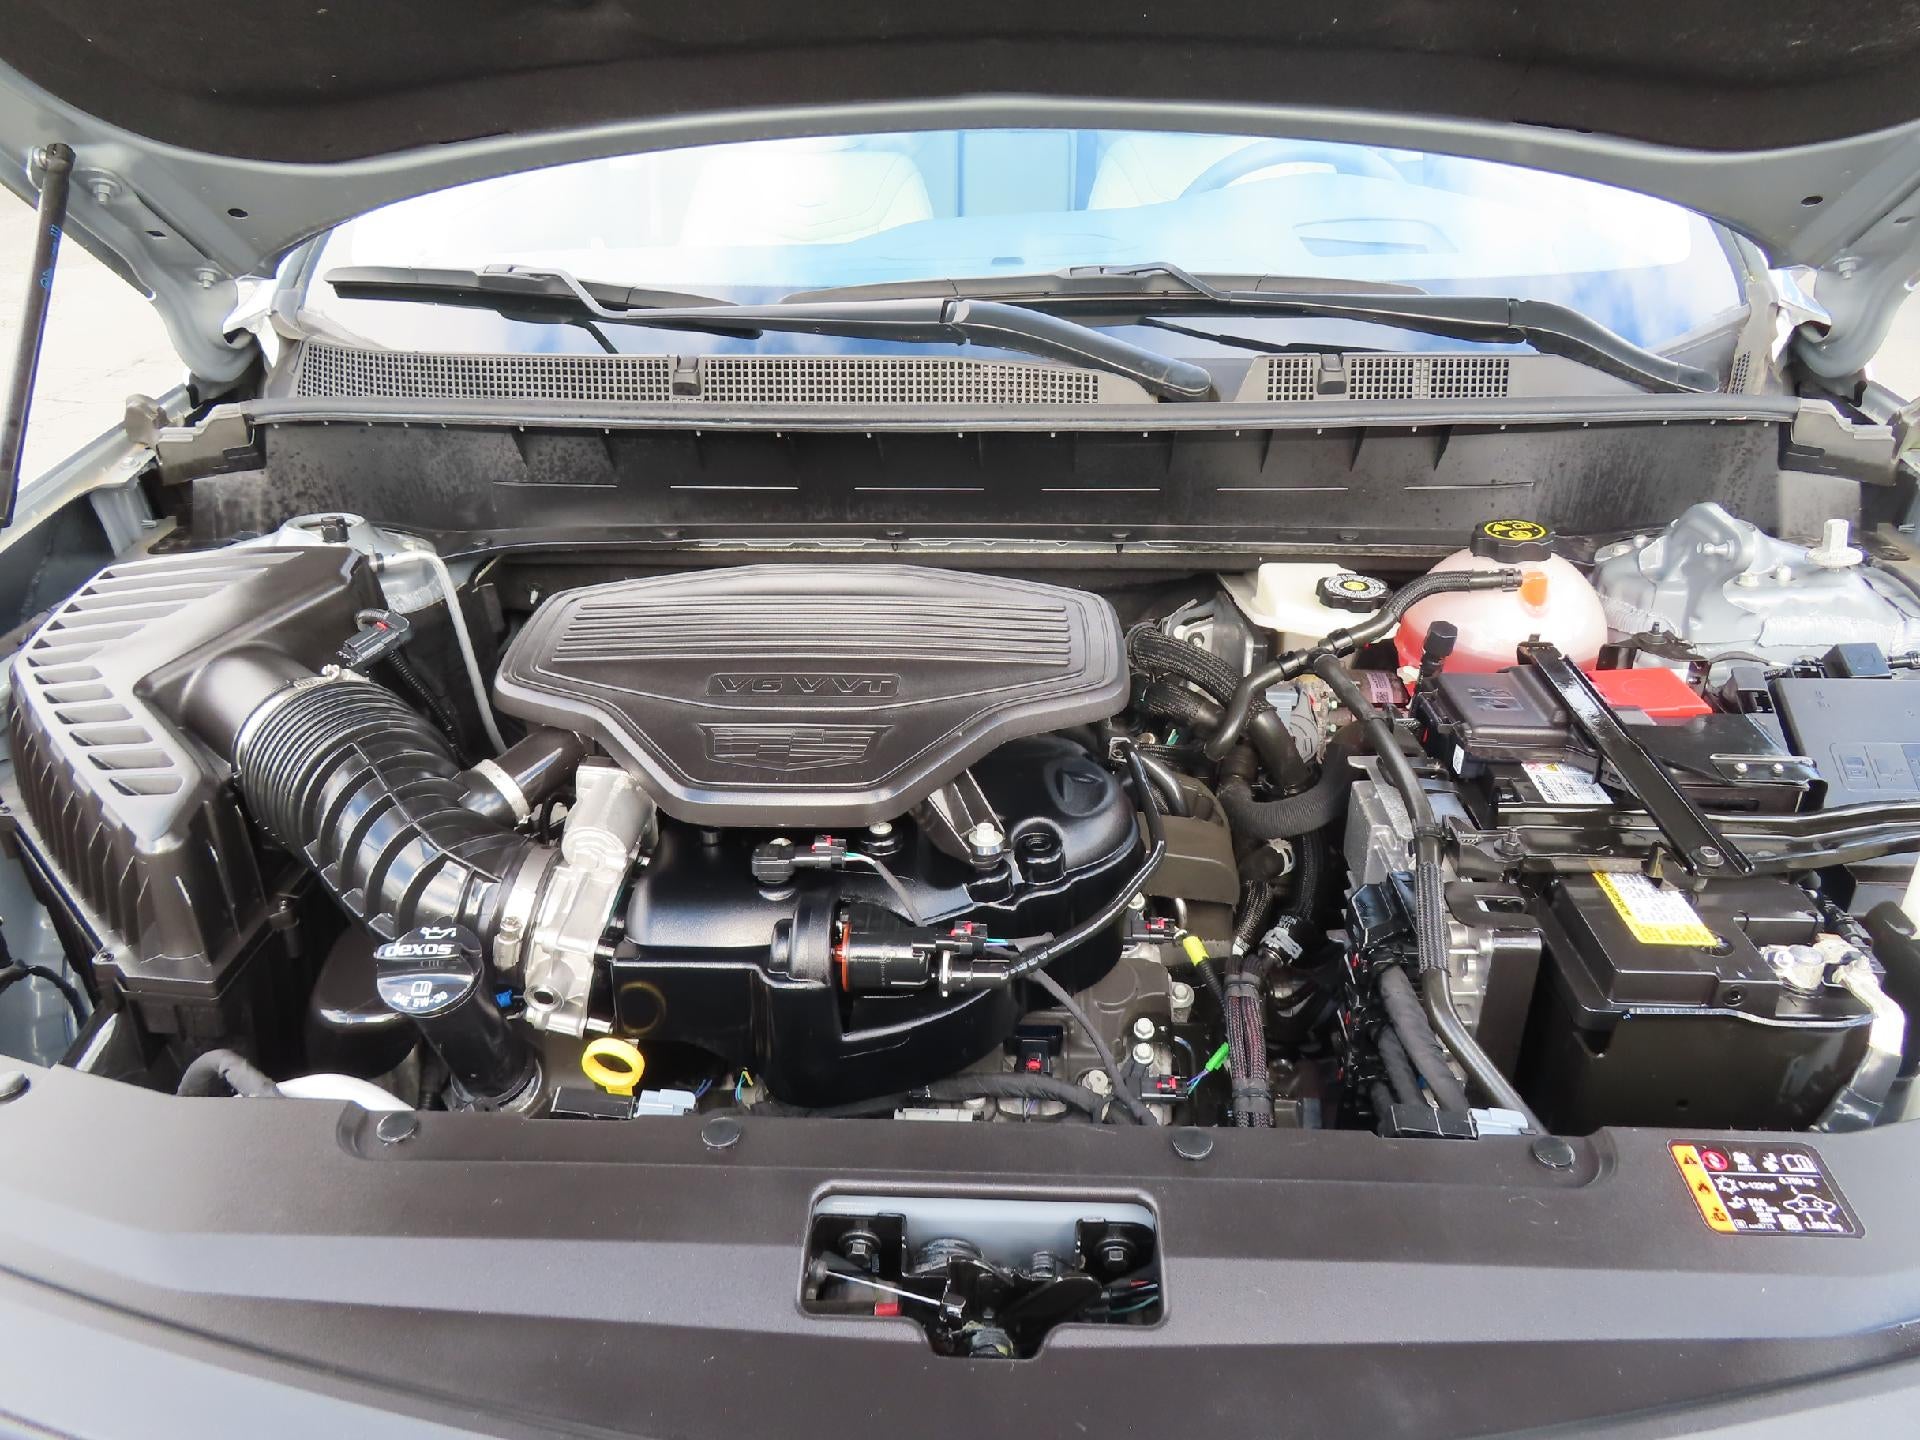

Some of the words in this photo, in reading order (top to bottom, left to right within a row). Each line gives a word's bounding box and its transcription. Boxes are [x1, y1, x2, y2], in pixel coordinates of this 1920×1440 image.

[717, 676, 783, 693] V6
[793, 676, 892, 693] VVT
[384, 942, 455, 958] dexos
